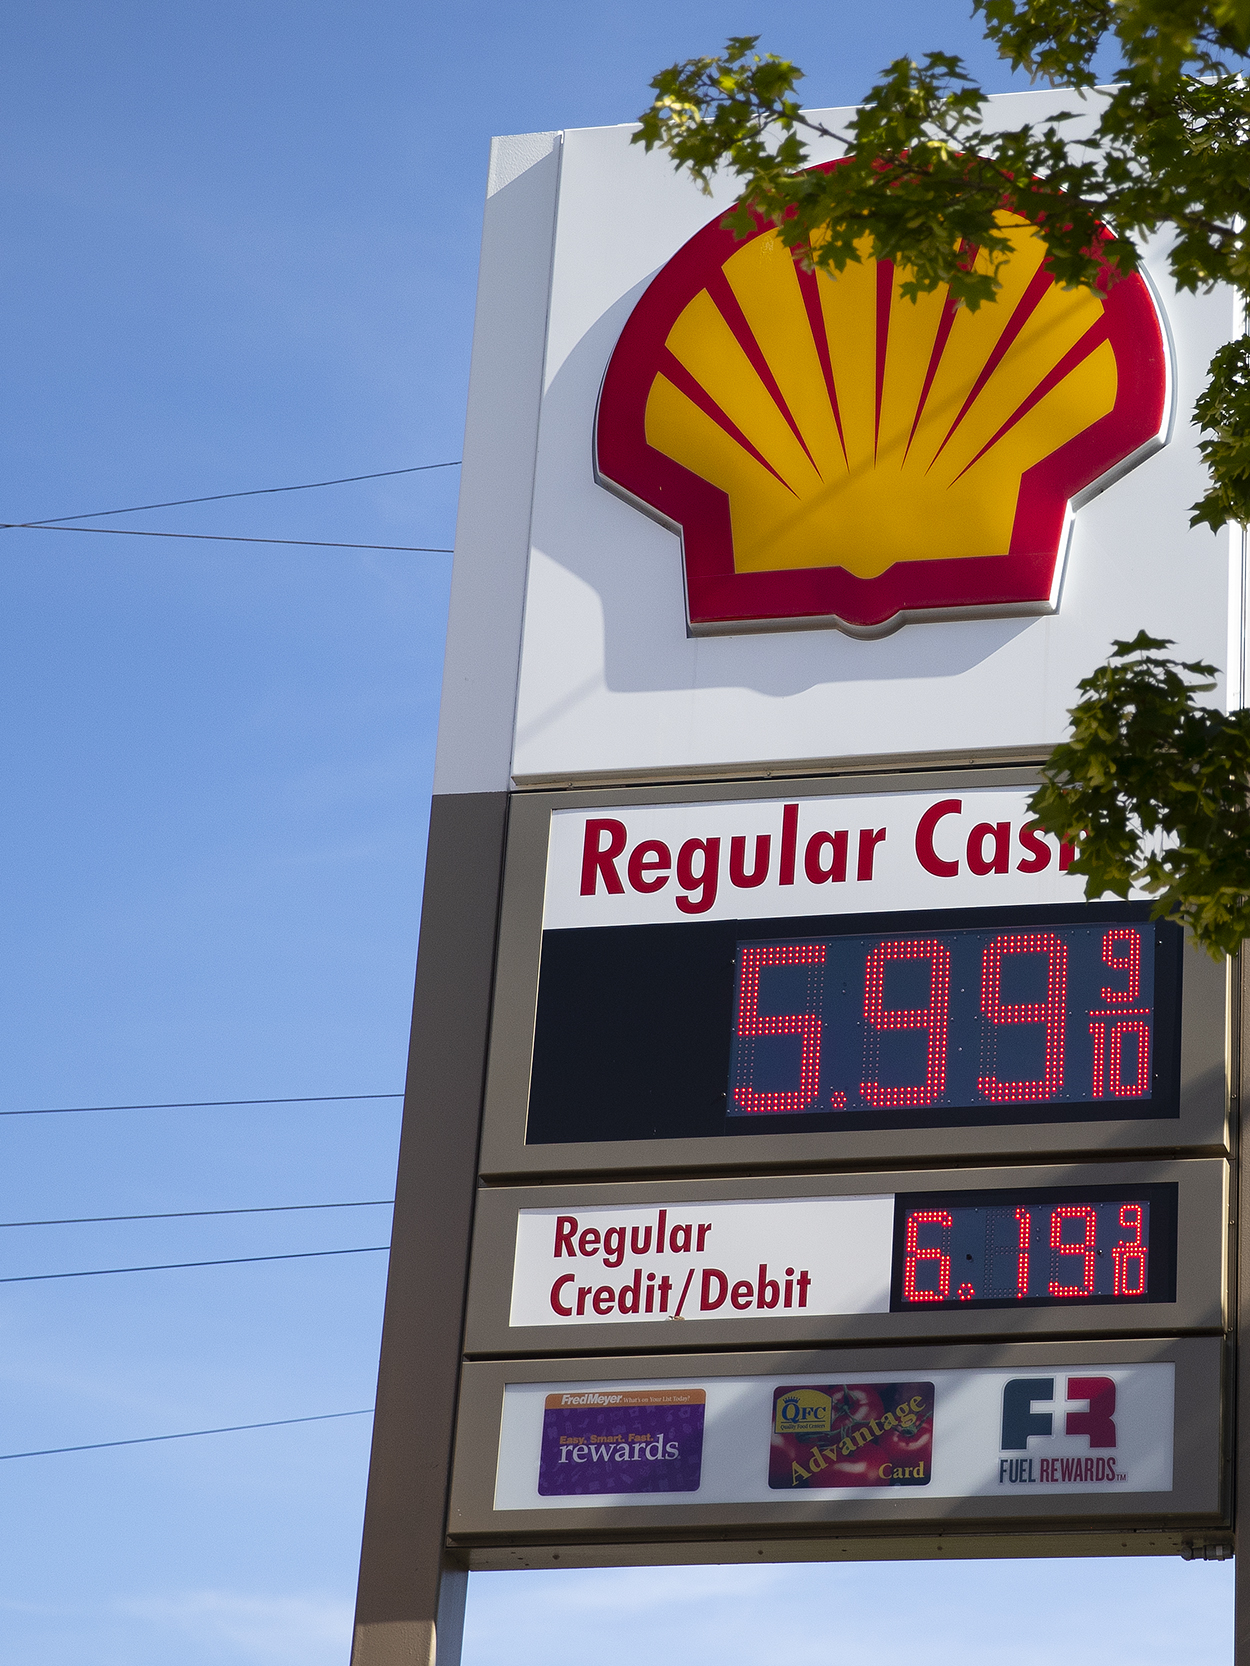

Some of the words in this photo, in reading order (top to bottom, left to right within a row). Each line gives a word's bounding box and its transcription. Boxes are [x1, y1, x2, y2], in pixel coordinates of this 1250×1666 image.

[580, 803, 887, 915] Regular
[553, 1209, 712, 1268] Regular
[550, 1263, 812, 1317] Credit/Debit
[781, 1403, 827, 1424] QFC
[558, 1433, 680, 1463] rewards
[791, 1395, 926, 1487] Advantage
[878, 1461, 925, 1479] Card
[999, 1458, 1036, 1484] FUEL
